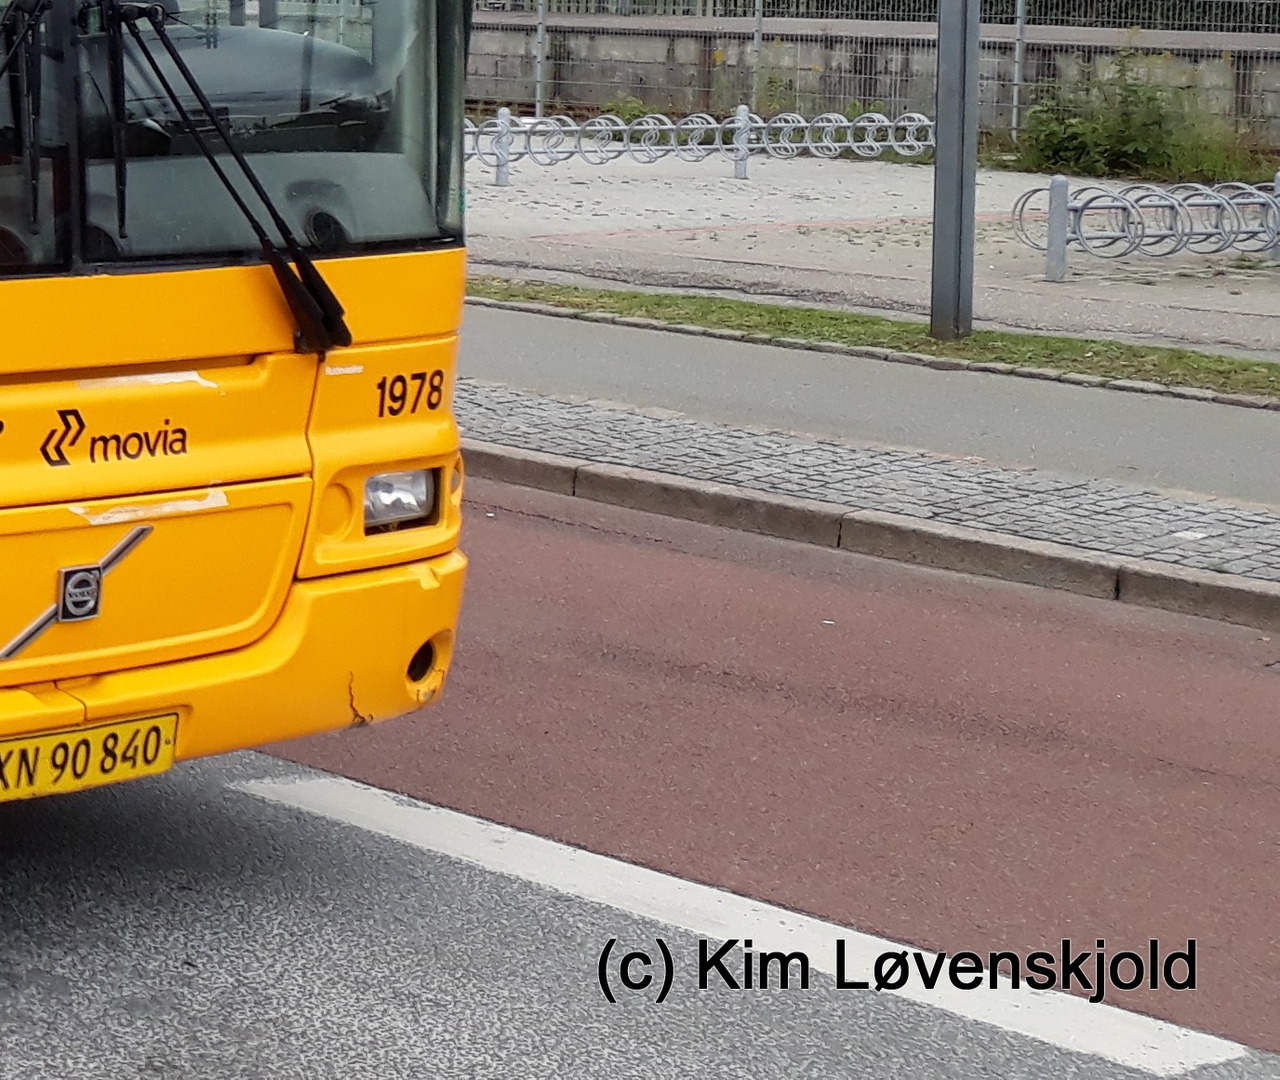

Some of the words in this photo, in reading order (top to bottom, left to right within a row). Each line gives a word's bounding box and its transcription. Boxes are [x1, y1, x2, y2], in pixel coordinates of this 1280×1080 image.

[377, 369, 444, 418] 1978
[90, 418, 188, 463] movia
[51, 738, 91, 784] 90
[100, 725, 162, 775] 840
